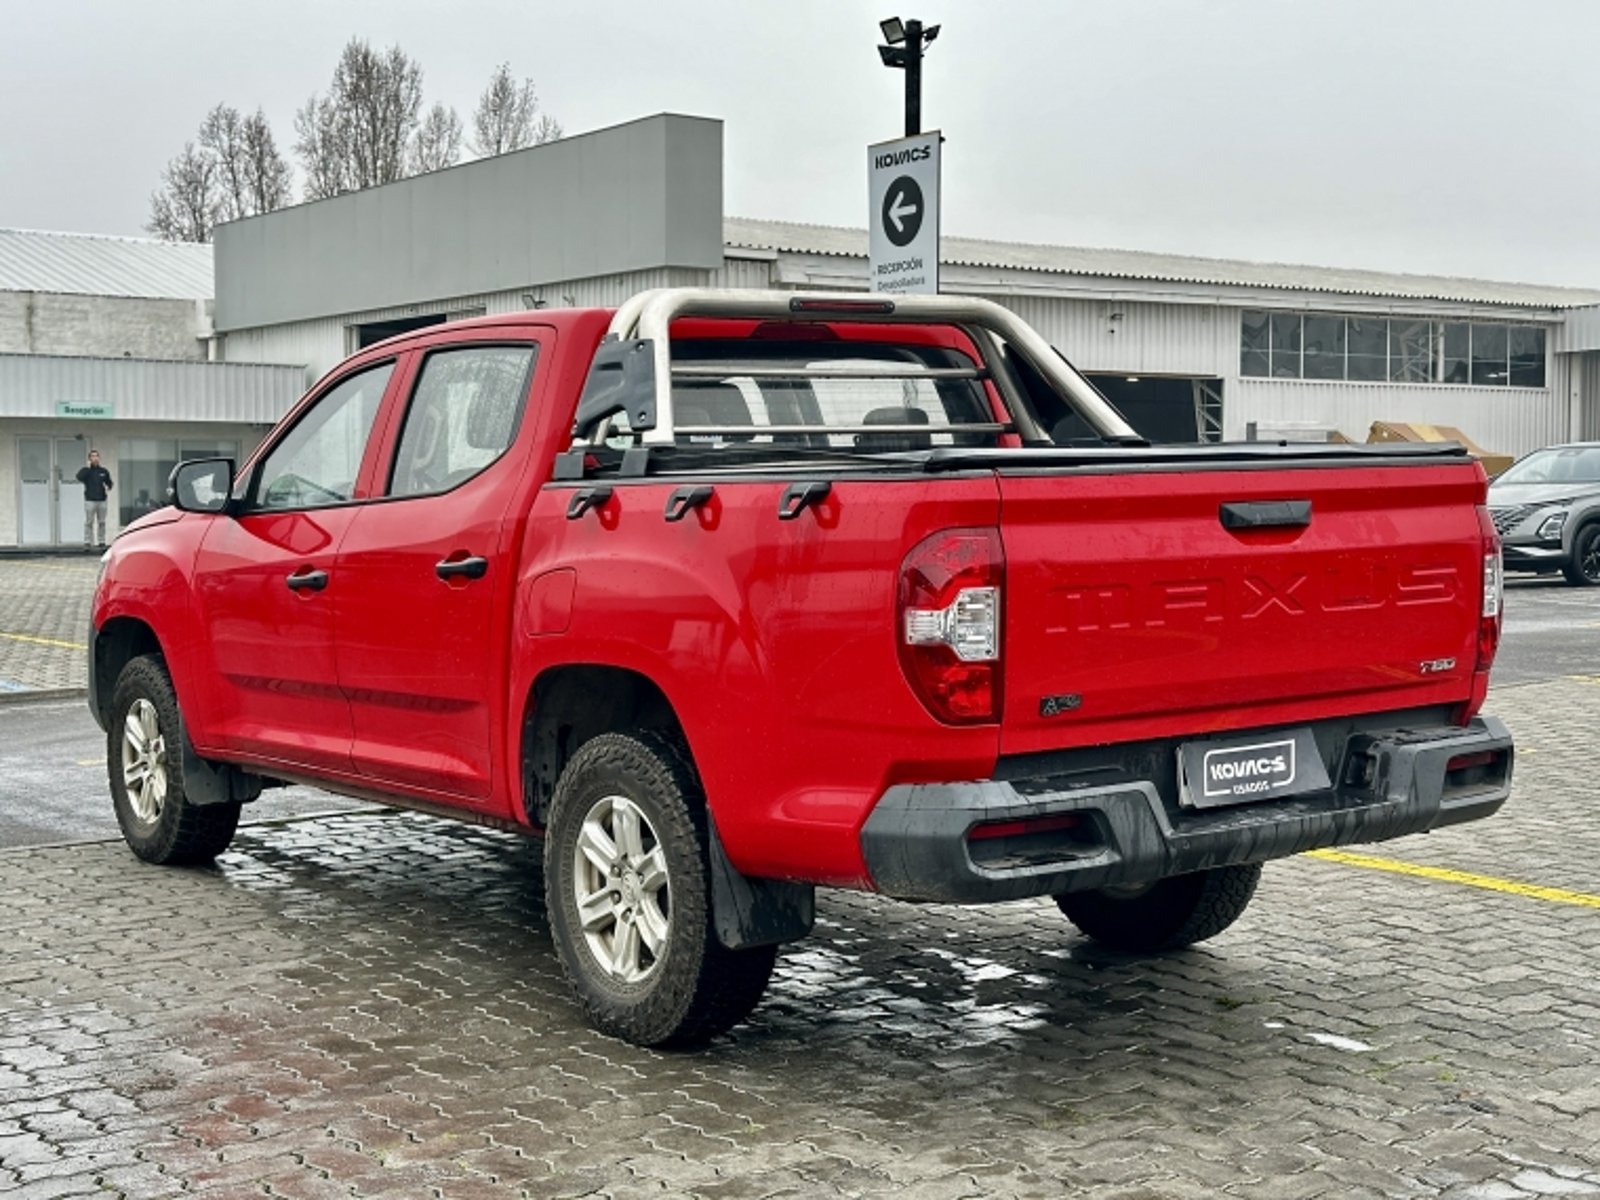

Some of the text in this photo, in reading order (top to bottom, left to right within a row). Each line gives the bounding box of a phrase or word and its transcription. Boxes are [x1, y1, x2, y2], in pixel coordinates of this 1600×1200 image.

[875, 145, 931, 169] KOVACS
[1045, 566, 1459, 633] MAXUS
[1210, 755, 1287, 780] KOVACS
[1232, 780, 1270, 795] USADOS
